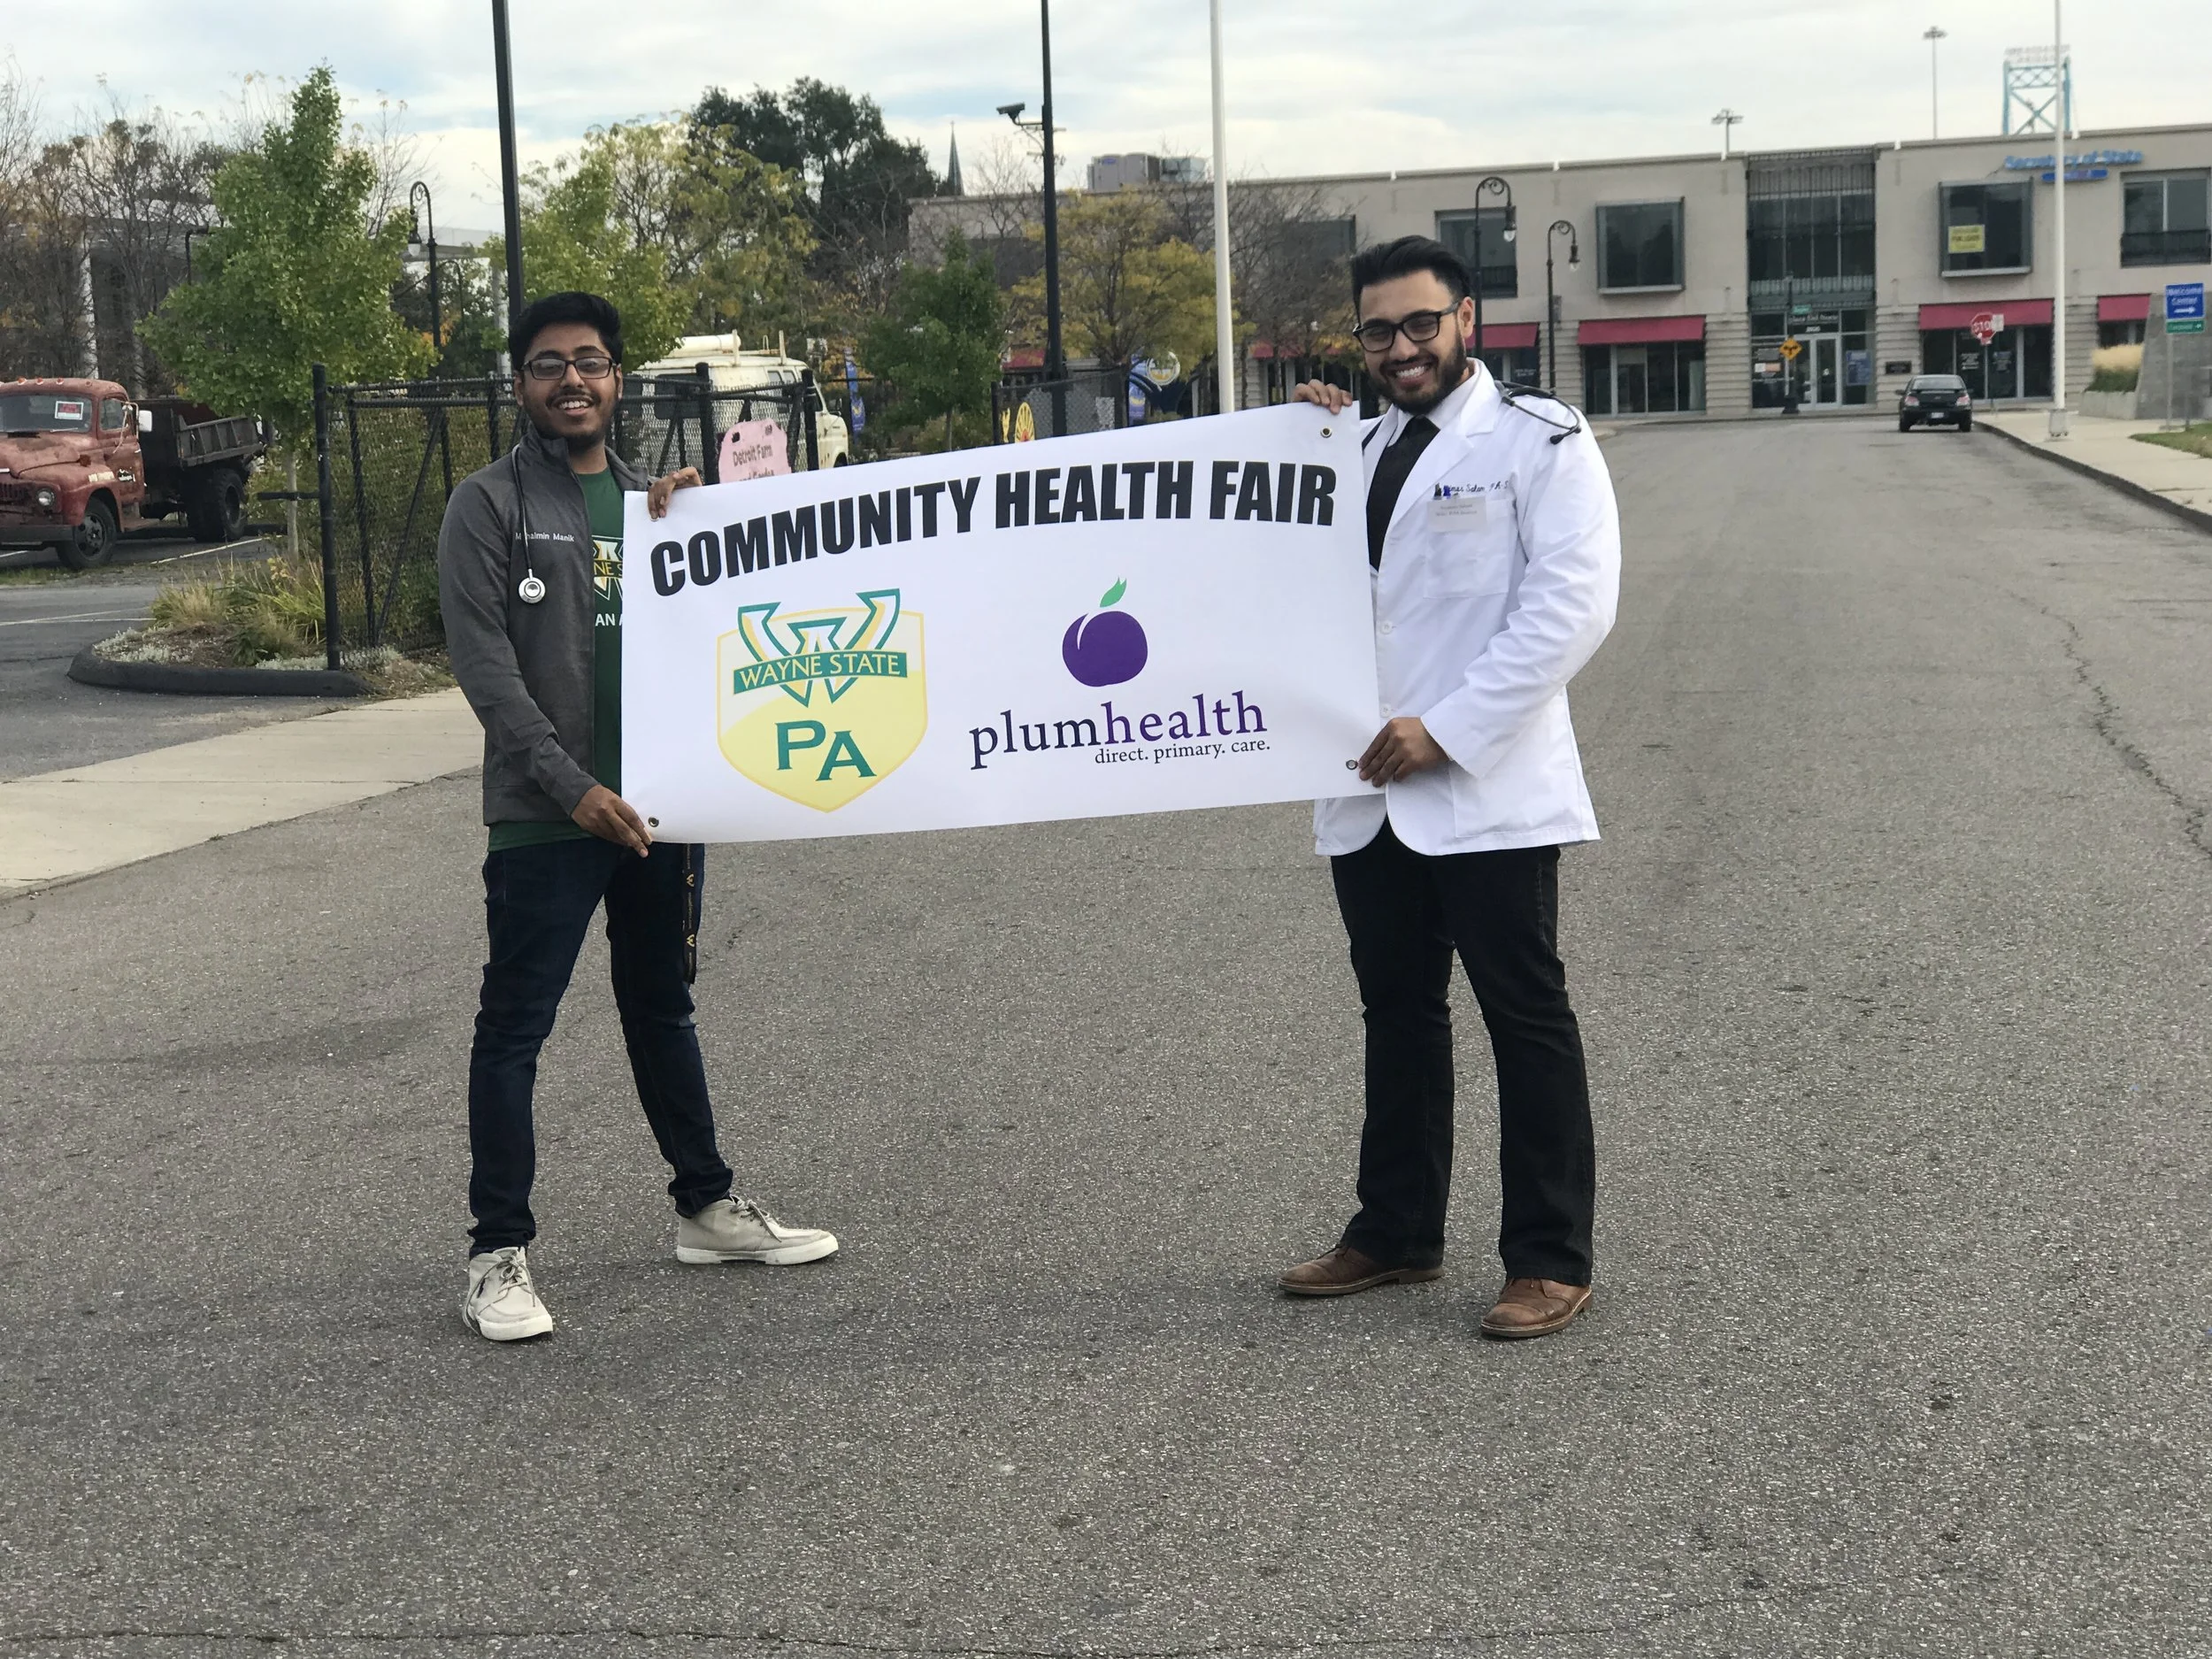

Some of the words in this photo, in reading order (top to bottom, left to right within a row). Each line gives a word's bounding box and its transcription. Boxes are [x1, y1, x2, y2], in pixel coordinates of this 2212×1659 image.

[1973, 320, 1993, 333] STO
[733, 445, 757, 467] Detroit
[757, 444, 773, 459] Farm
[552, 532, 575, 542] Manik
[651, 476, 981, 597] COMMUNITY
[995, 460, 1194, 529] HEALTH
[1209, 461, 1337, 526] FAIR
[739, 655, 823, 690] WAYNE
[829, 652, 901, 676] STATE
[969, 690, 1268, 771] plumhealth
[774, 719, 878, 781] PA
[1094, 748, 1149, 764] direct.
[1154, 742, 1226, 764] primary.
[1231, 738, 1271, 754] care.
